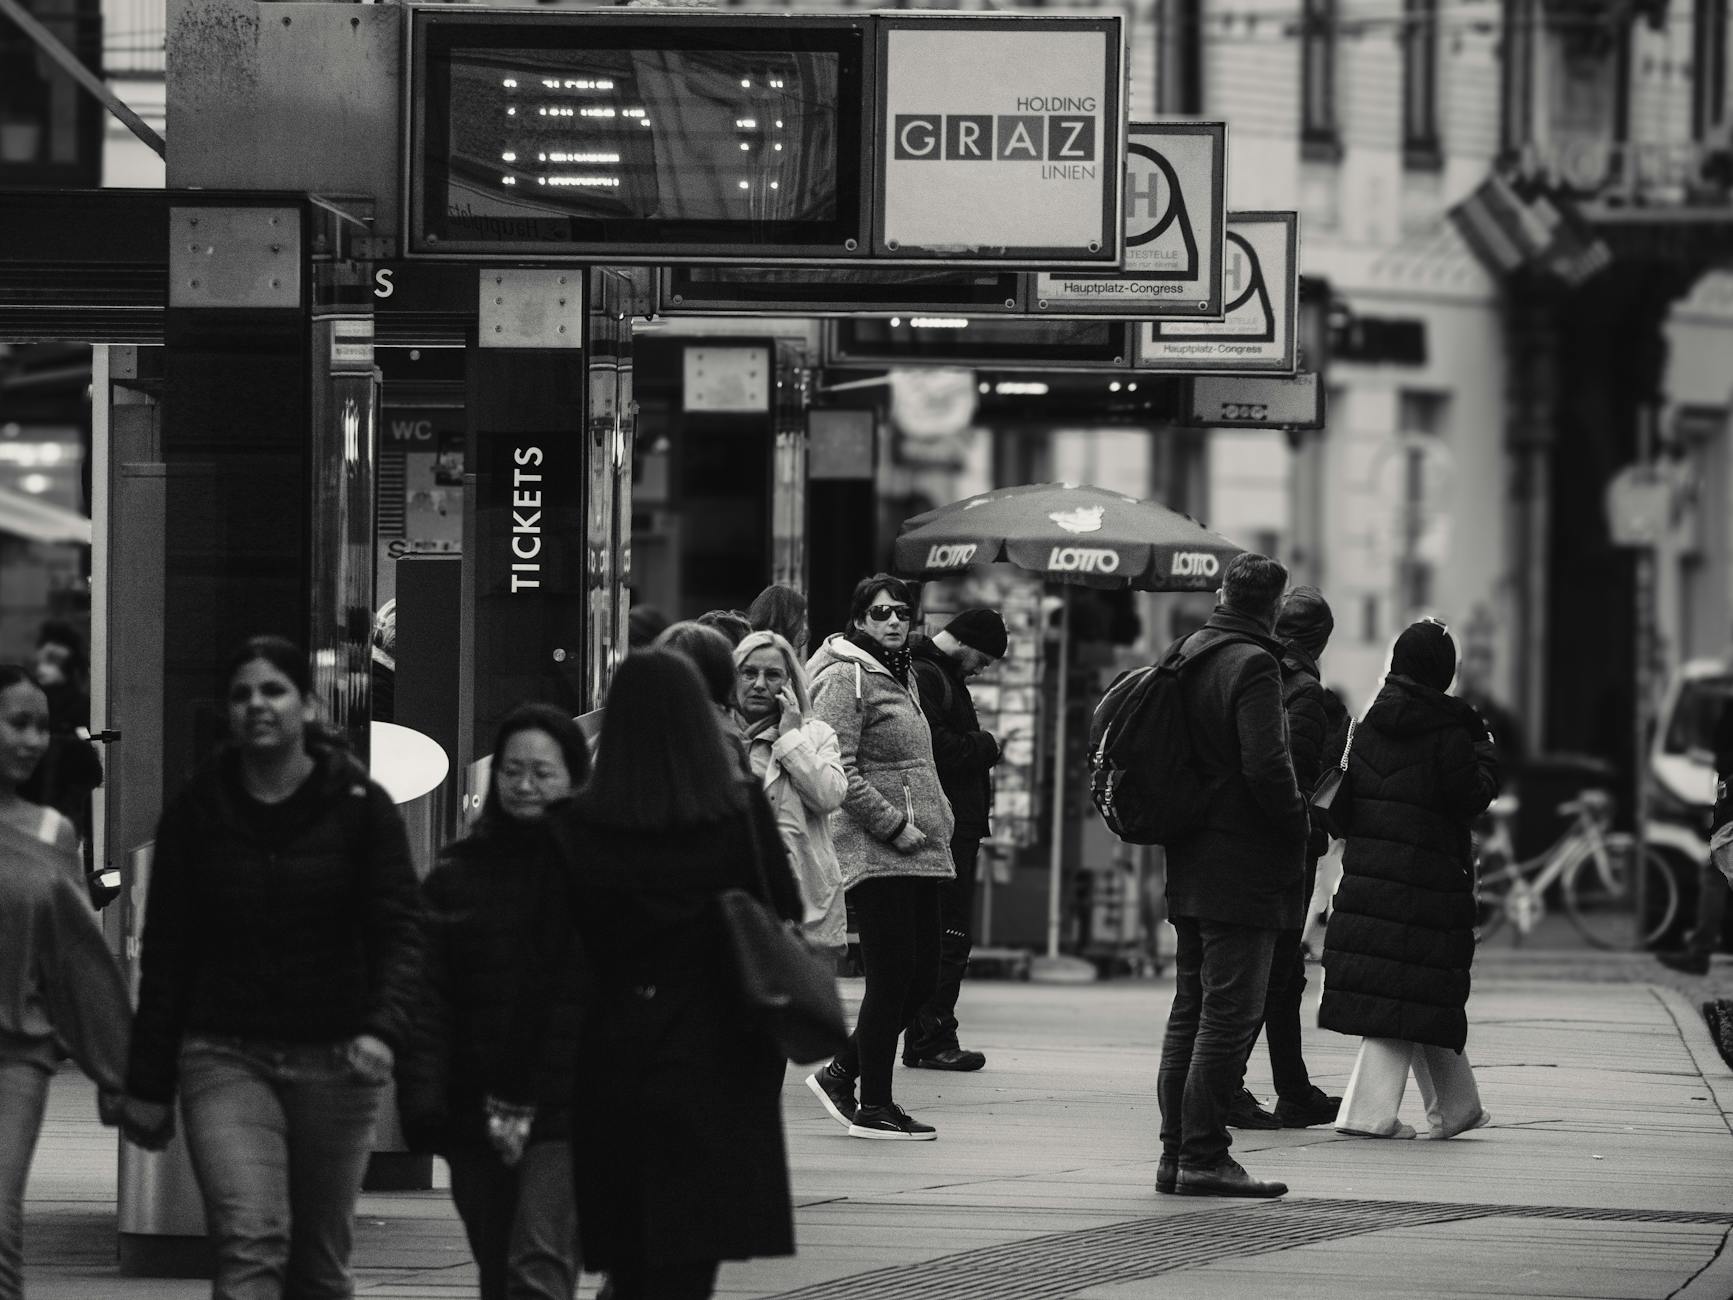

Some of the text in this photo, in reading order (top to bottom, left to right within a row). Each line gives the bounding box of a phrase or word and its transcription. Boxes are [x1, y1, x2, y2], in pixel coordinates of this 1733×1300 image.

[1016, 96, 1097, 113] HOLDING
[899, 119, 1087, 157] GRAZ
[1041, 164, 1096, 181] LINIEN
[1127, 172, 1158, 219] H
[374, 268, 394, 298] S
[1063, 282, 1184, 296] Hauptplatz-Congress
[1163, 344, 1263, 355] Hauptplatz-Congress
[392, 419, 432, 442] WC
[511, 446, 544, 594] TICKETS
[925, 543, 978, 569] LOTTO
[1047, 546, 1120, 573] LOTTO
[1171, 551, 1220, 577] LOTTO
